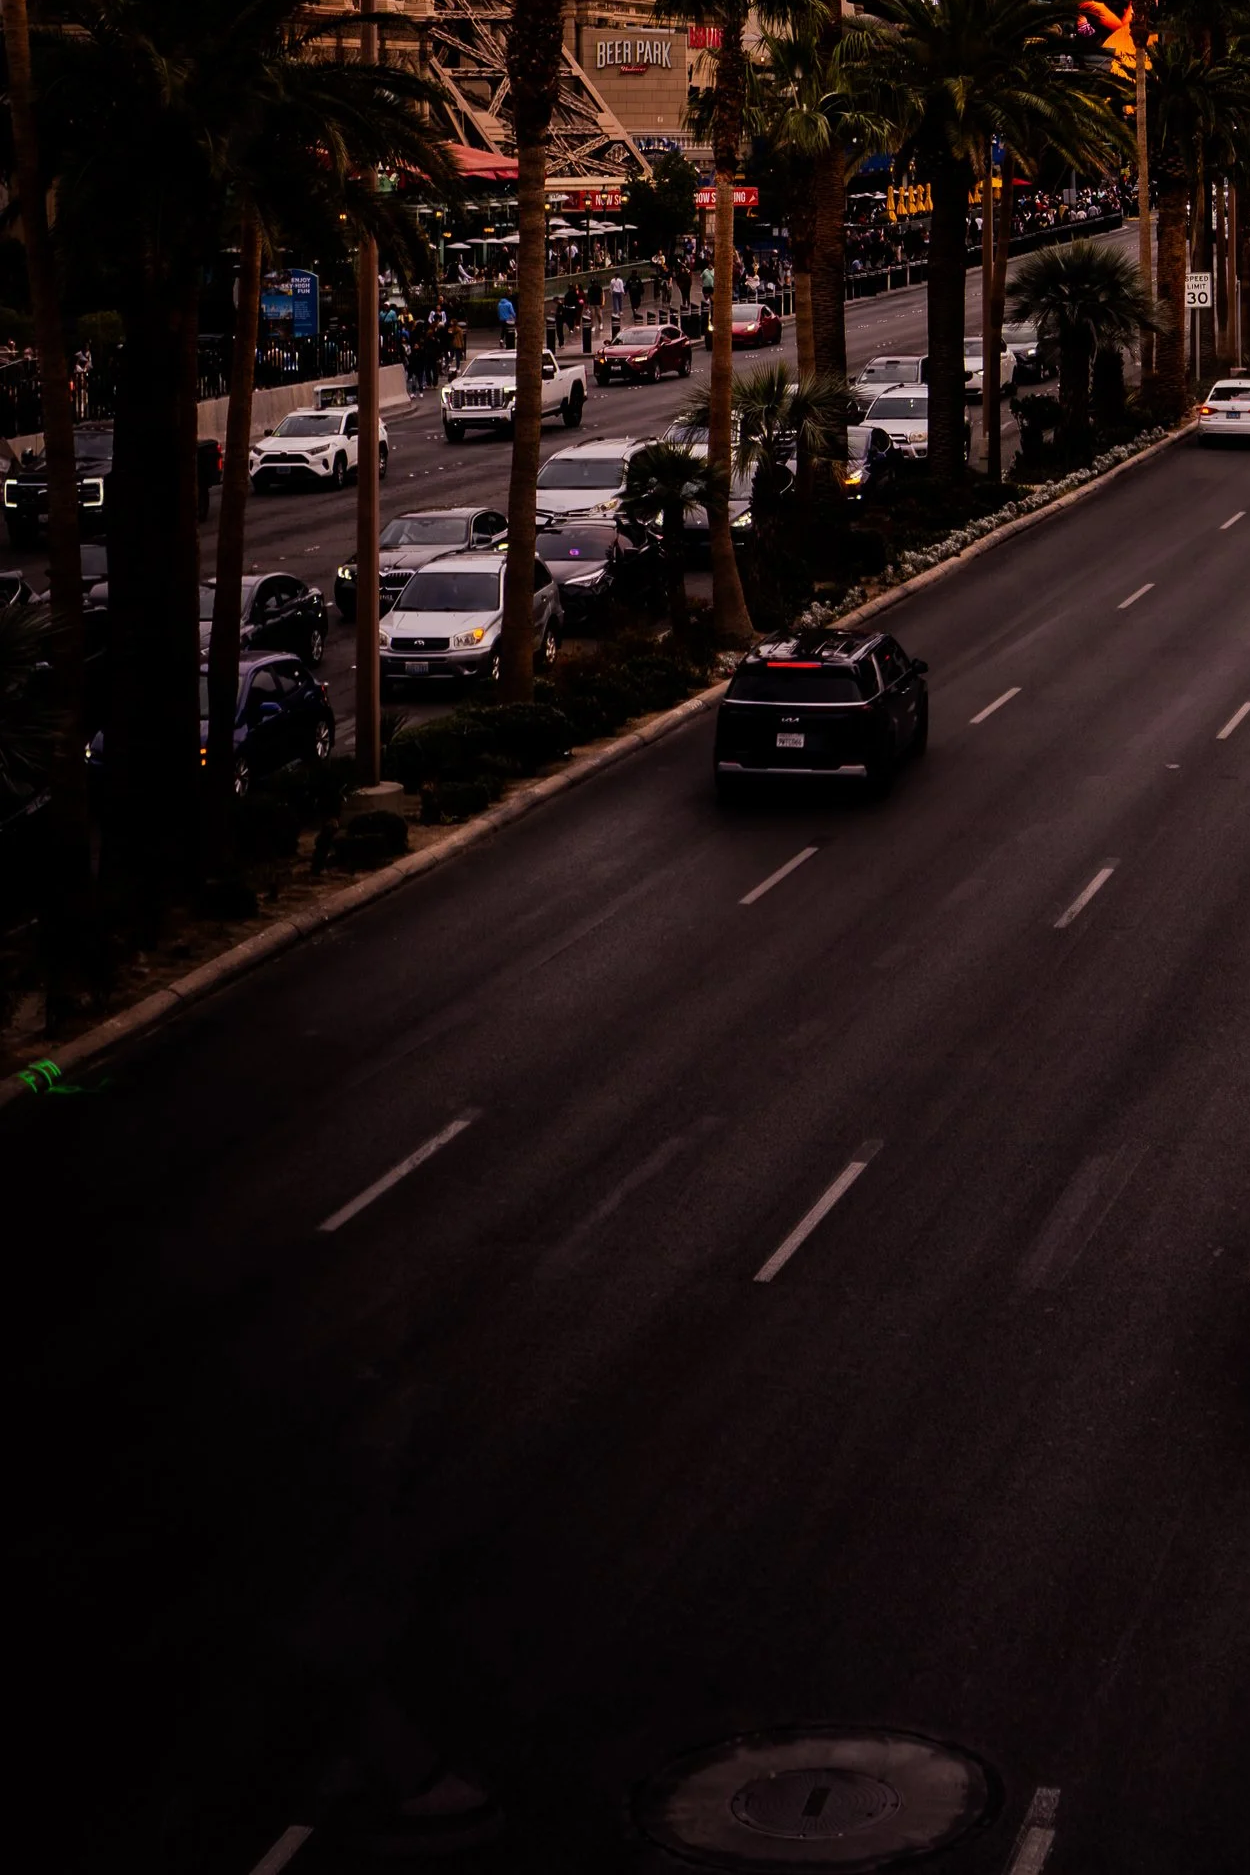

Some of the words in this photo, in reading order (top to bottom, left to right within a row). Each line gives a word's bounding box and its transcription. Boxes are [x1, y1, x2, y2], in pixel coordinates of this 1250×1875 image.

[596, 39, 633, 69] BEER
[636, 39, 672, 69] PARK
[1187, 292, 1208, 304] 30
